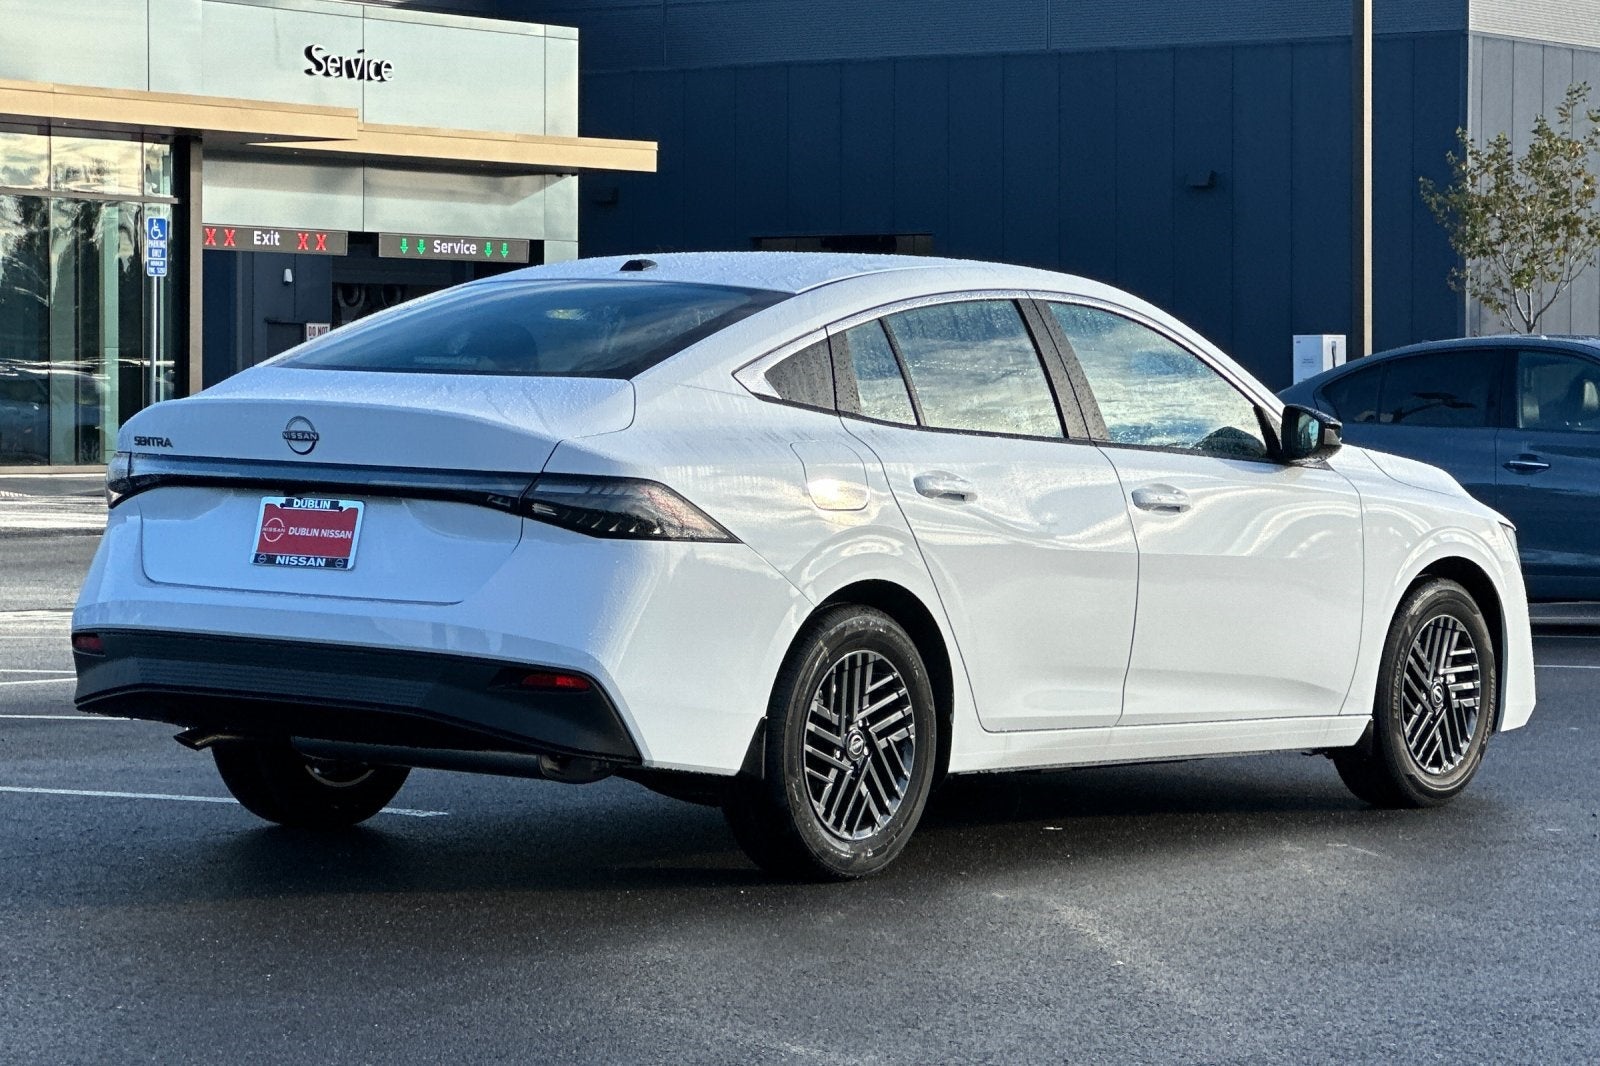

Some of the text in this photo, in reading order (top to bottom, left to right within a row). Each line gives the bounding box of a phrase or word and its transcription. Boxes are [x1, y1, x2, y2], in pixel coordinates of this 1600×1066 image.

[305, 44, 394, 82] Service
[253, 230, 280, 246] Exit
[433, 239, 477, 255] Service
[308, 326, 329, 337] DO NOT
[134, 436, 173, 448] SENTRA
[282, 431, 319, 441] NISSAN
[293, 499, 331, 509] DUBLIN
[288, 527, 353, 539] DUBLIN NISSAN
[275, 555, 326, 567] NISSAN
